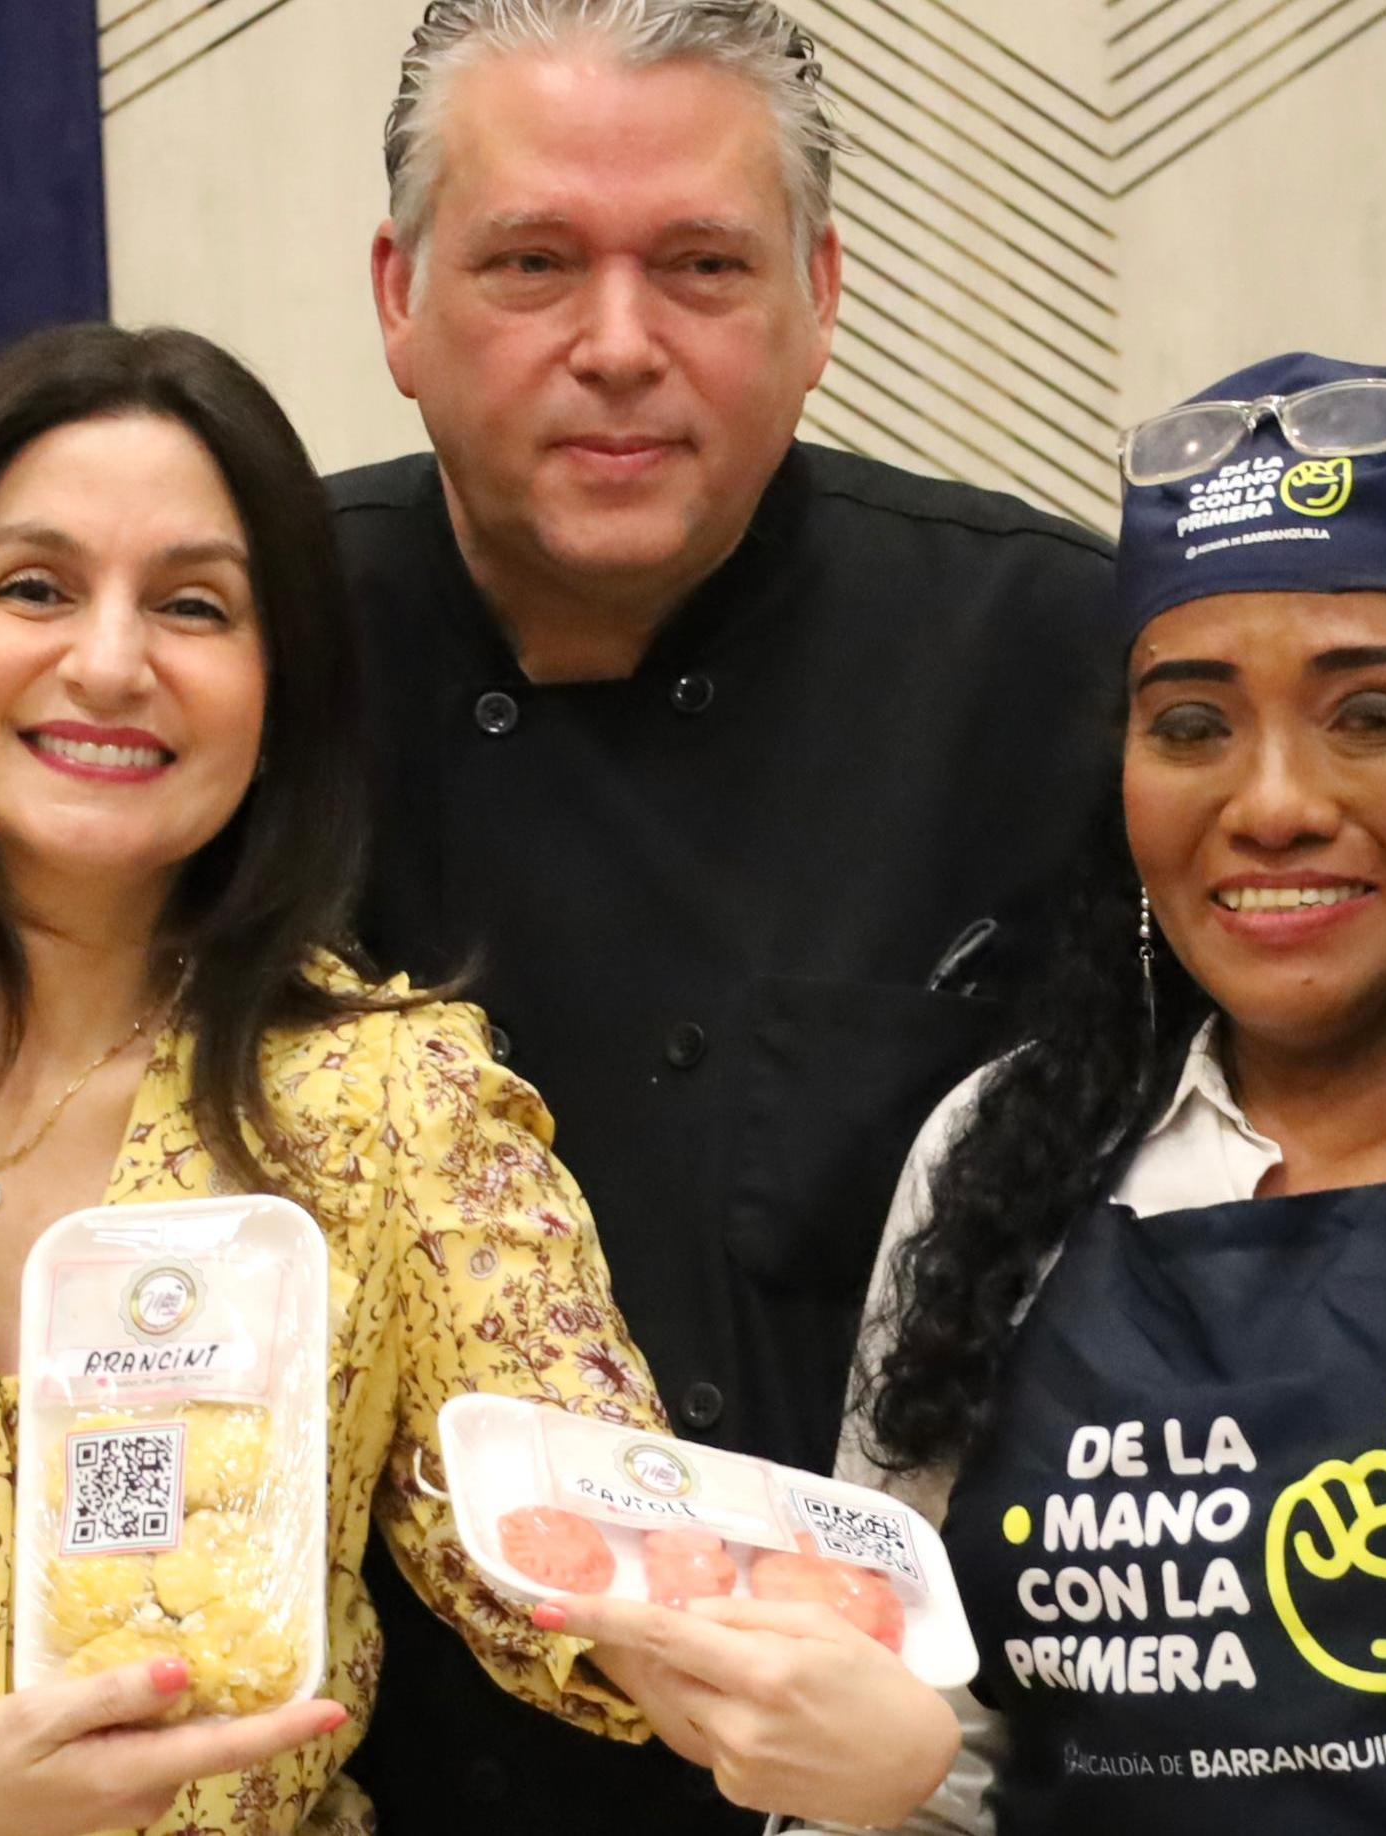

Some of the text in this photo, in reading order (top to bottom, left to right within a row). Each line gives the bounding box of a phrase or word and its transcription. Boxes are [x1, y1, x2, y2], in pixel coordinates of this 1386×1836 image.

[1219, 456, 1284, 478] DE LA
[1205, 469, 1281, 494] MANO
[1189, 484, 1276, 511] CON LA
[1067, 1416, 1257, 1479] DE LA
[1044, 1487, 1251, 1552] MANO
[1018, 1558, 1251, 1622] CON LA
[1159, 1755, 1184, 1775] DE
